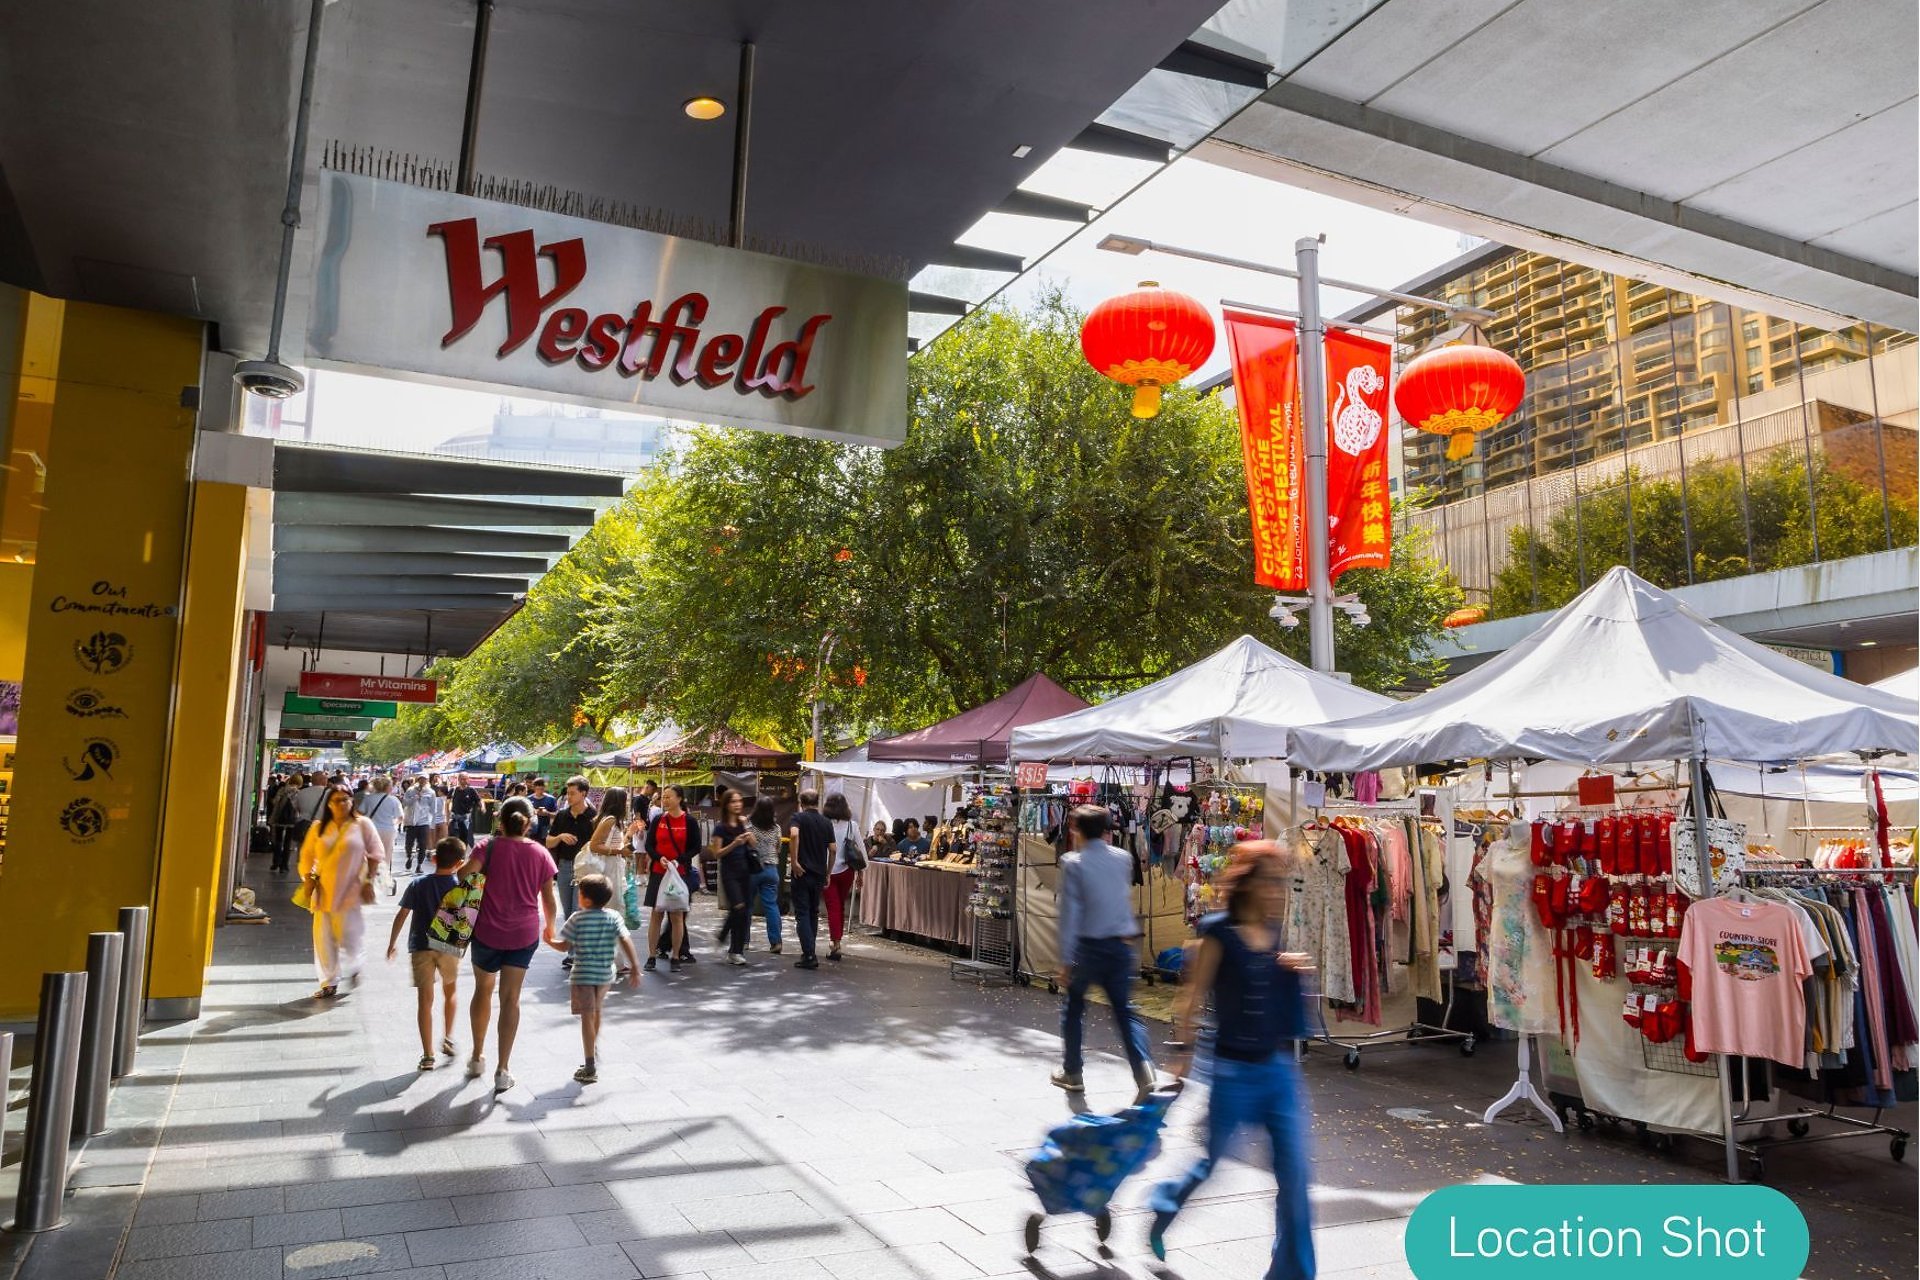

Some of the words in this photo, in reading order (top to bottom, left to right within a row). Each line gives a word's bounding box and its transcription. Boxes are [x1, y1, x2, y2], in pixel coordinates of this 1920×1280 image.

[427, 217, 832, 398] Westfield
[1257, 438, 1272, 480] THE
[1269, 402, 1289, 501] FESTIVAL
[1249, 433, 1274, 575] CHATSWO
[1263, 486, 1276, 516] OF
[1288, 487, 1299, 501] 16
[1361, 460, 1385, 545] 新年快樂
[91, 580, 127, 600] Our
[50, 596, 163, 619] Commitments
[360, 678, 376, 689] Mr
[377, 679, 428, 692] Vitamins
[1719, 930, 1755, 943] COUNTRY
